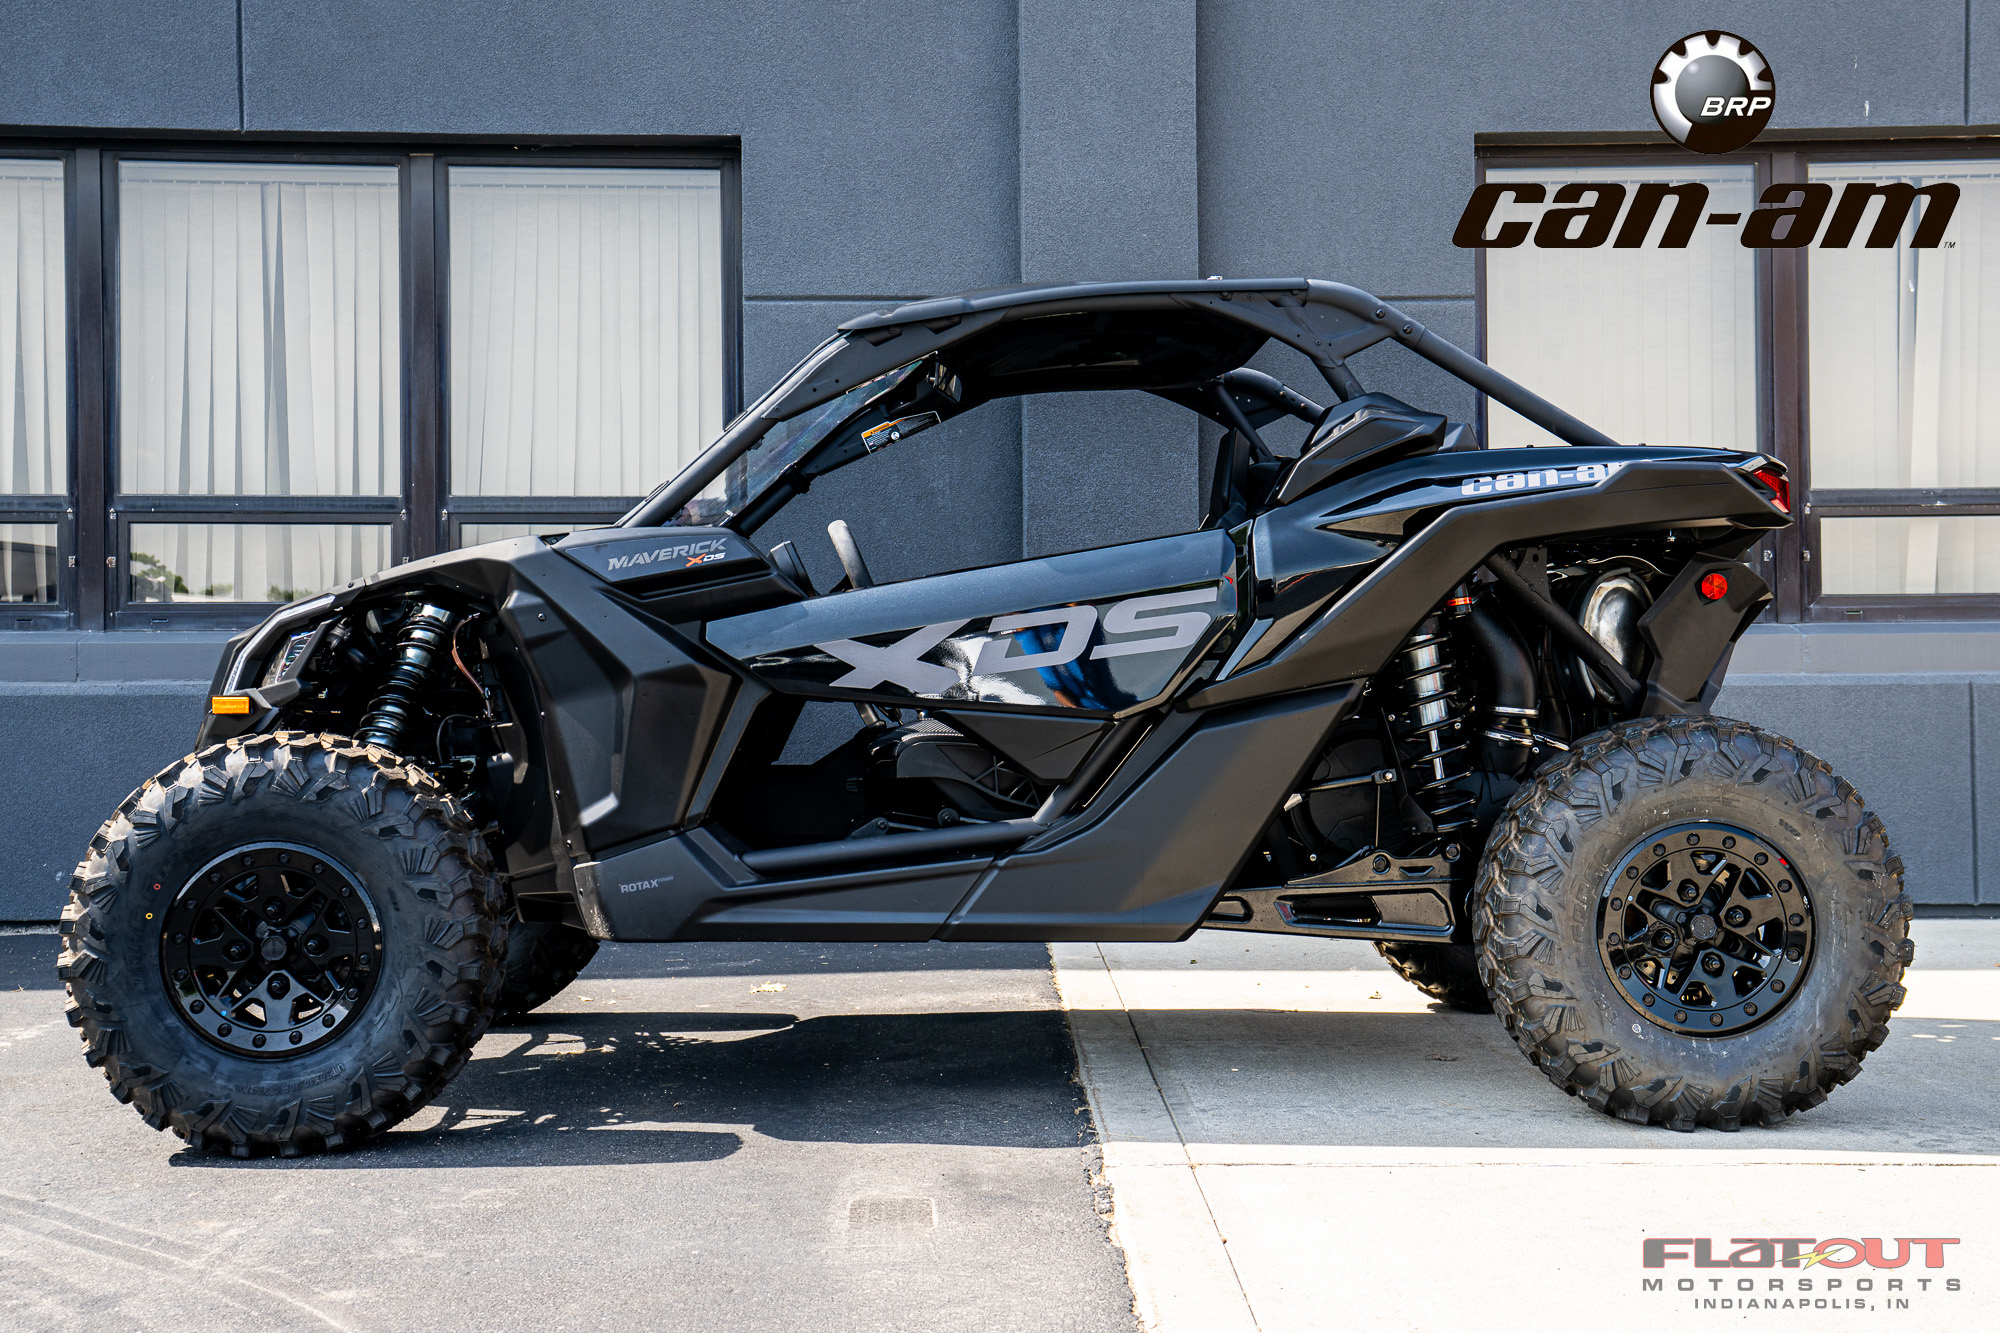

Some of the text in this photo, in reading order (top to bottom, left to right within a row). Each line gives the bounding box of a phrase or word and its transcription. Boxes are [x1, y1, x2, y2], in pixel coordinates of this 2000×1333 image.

[607, 537, 728, 571] MAVERICK
[685, 552, 726, 568] XDS
[813, 586, 1218, 696] XDS
[620, 879, 659, 894] ROTAX
